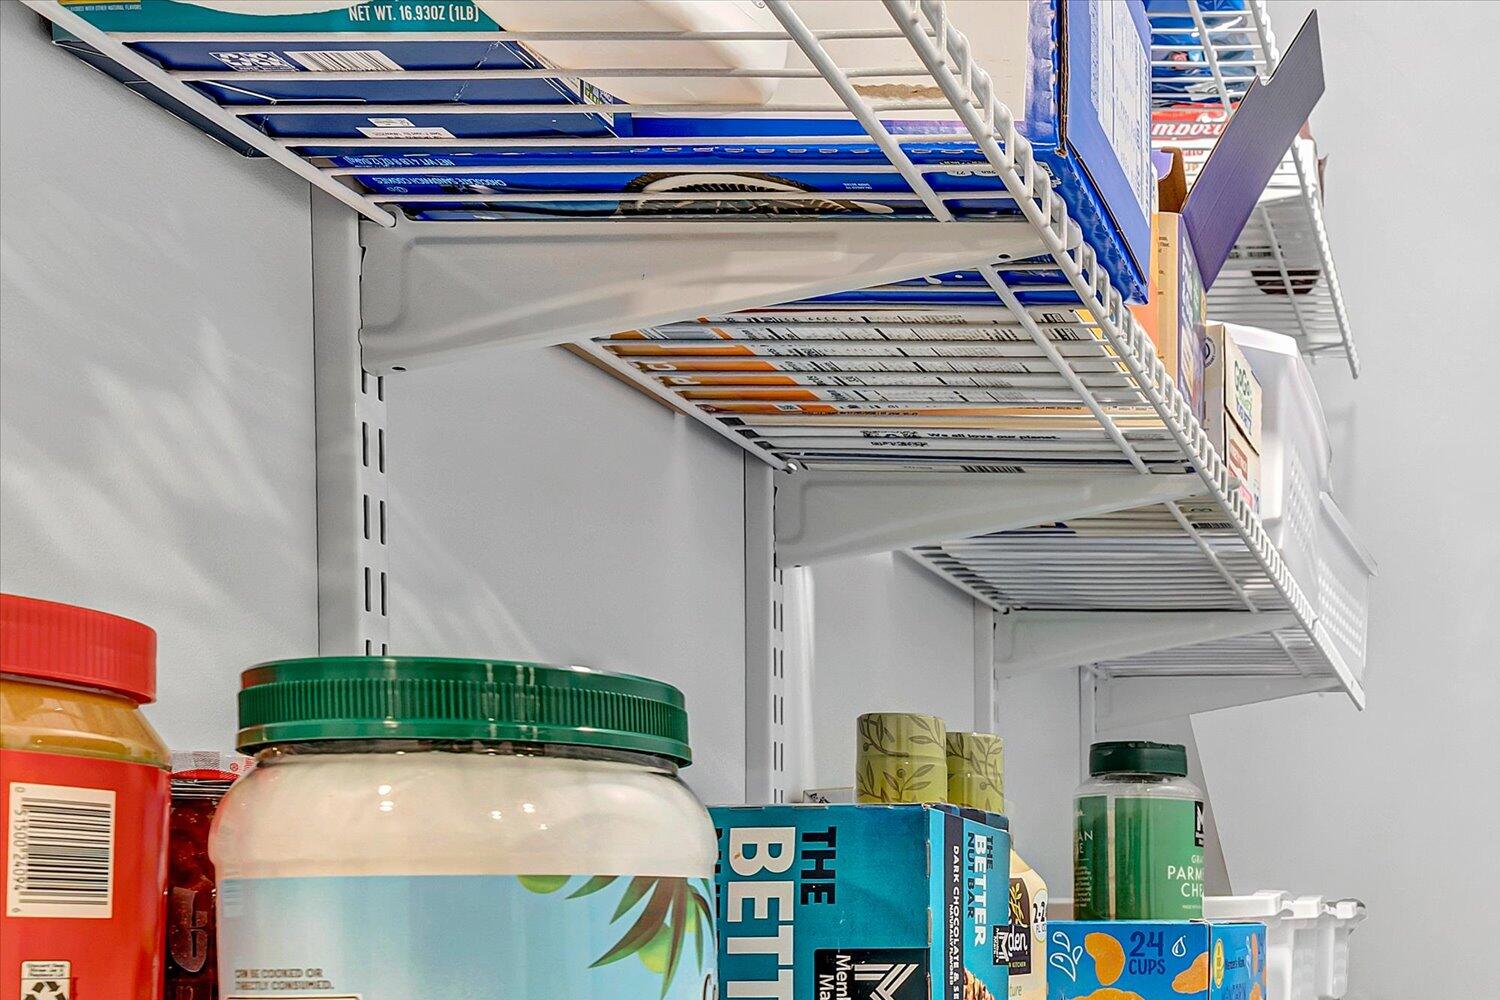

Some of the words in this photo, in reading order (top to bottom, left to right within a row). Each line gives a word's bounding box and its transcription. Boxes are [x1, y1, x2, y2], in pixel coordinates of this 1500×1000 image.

[349, 5, 371, 21] NET
[374, 5, 397, 21] WT.
[449, 4, 479, 22] (1LB)
[800, 826, 837, 905] THE
[952, 845, 960, 883] DARK
[967, 832, 975, 874] NUT
[986, 835, 994, 870] THE
[967, 877, 975, 919] BAR
[974, 834, 988, 947] BETTER
[952, 887, 960, 968] CHOCOLATE
[1129, 930, 1164, 957] 24
[261, 968, 303, 978] COOKED
[305, 968, 323, 978] OR
[952, 972, 960, 983] &
[1128, 958, 1166, 975] CUPS
